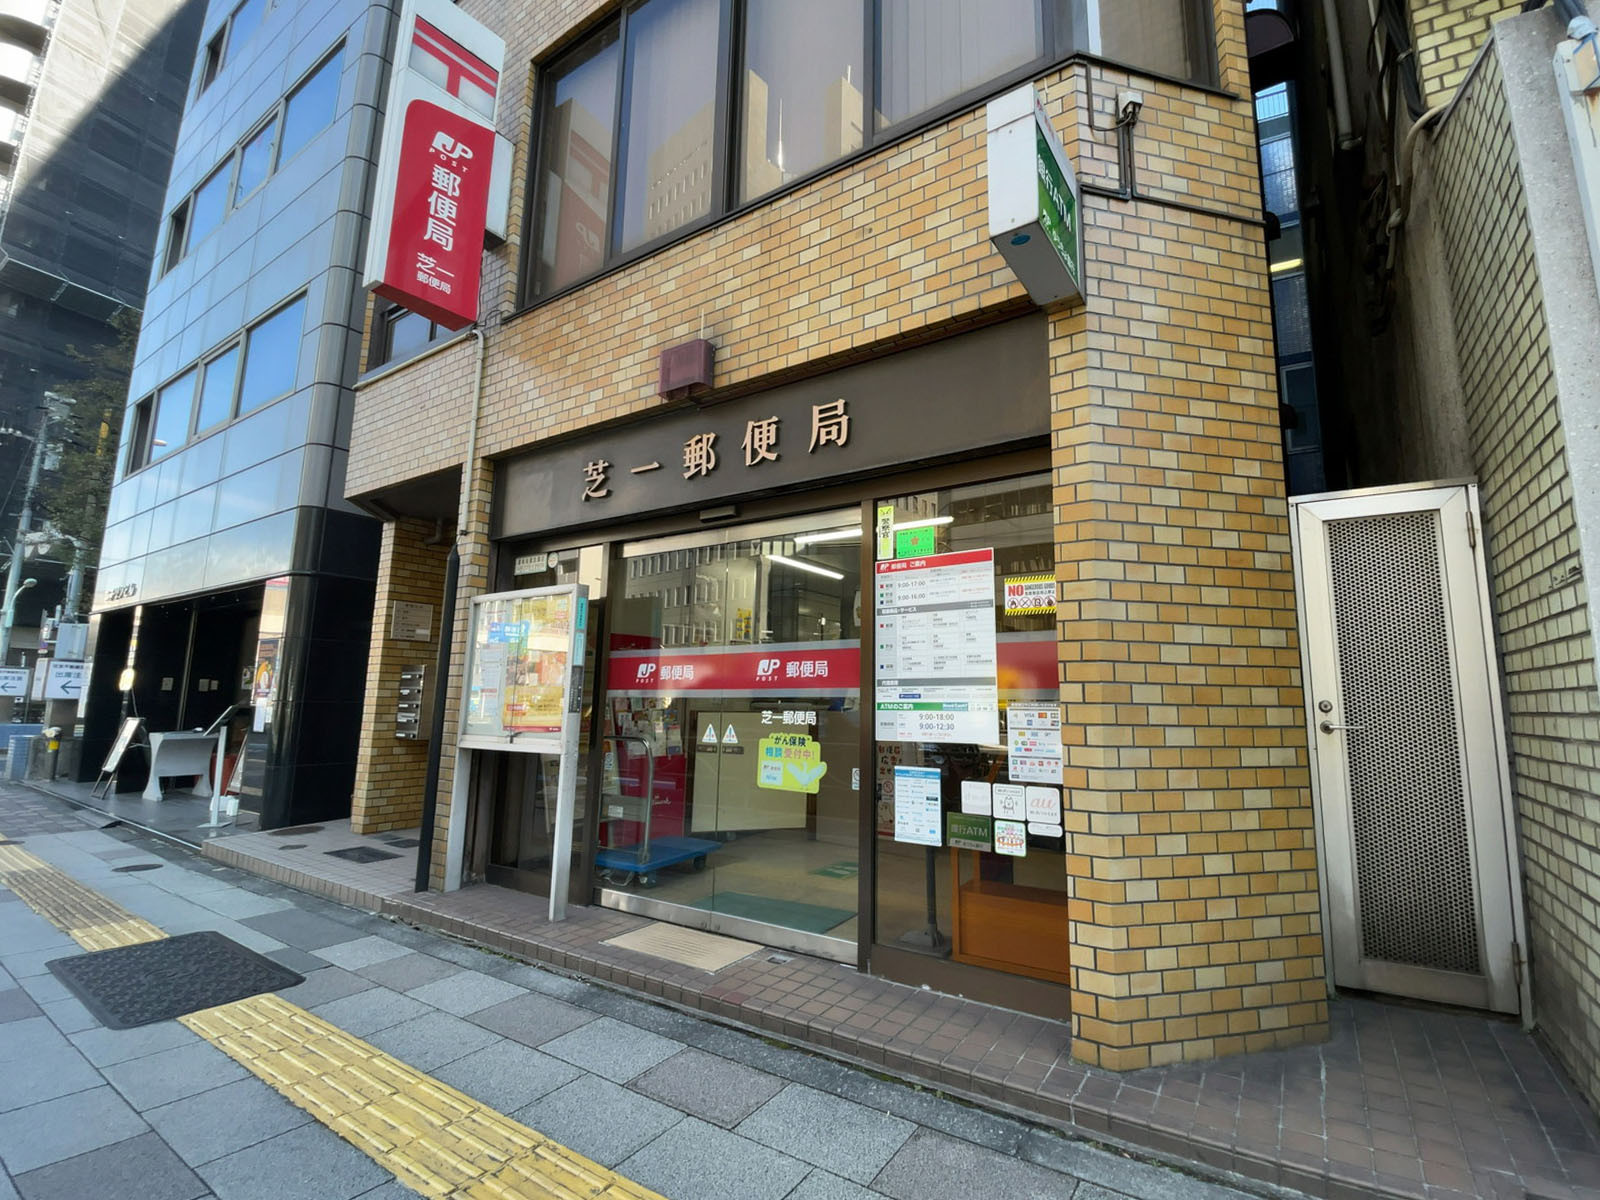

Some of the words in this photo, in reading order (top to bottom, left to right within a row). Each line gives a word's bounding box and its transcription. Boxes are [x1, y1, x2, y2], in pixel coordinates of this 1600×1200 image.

[428, 147, 469, 173] POST
[423, 163, 462, 252] 郵便局
[416, 251, 456, 279] 芝一
[416, 270, 453, 296] 郵便局
[581, 398, 850, 501] 芝一郵便局
[1008, 584, 1024, 597] NO
[660, 664, 694, 681] 郵便局
[786, 660, 829, 678] 郵便局
[761, 710, 817, 726] 芝一郵便局
[919, 713, 955, 721] 9:00-18:00
[919, 722, 955, 730] 9:00-12:30
[774, 735, 807, 747] がん保険
